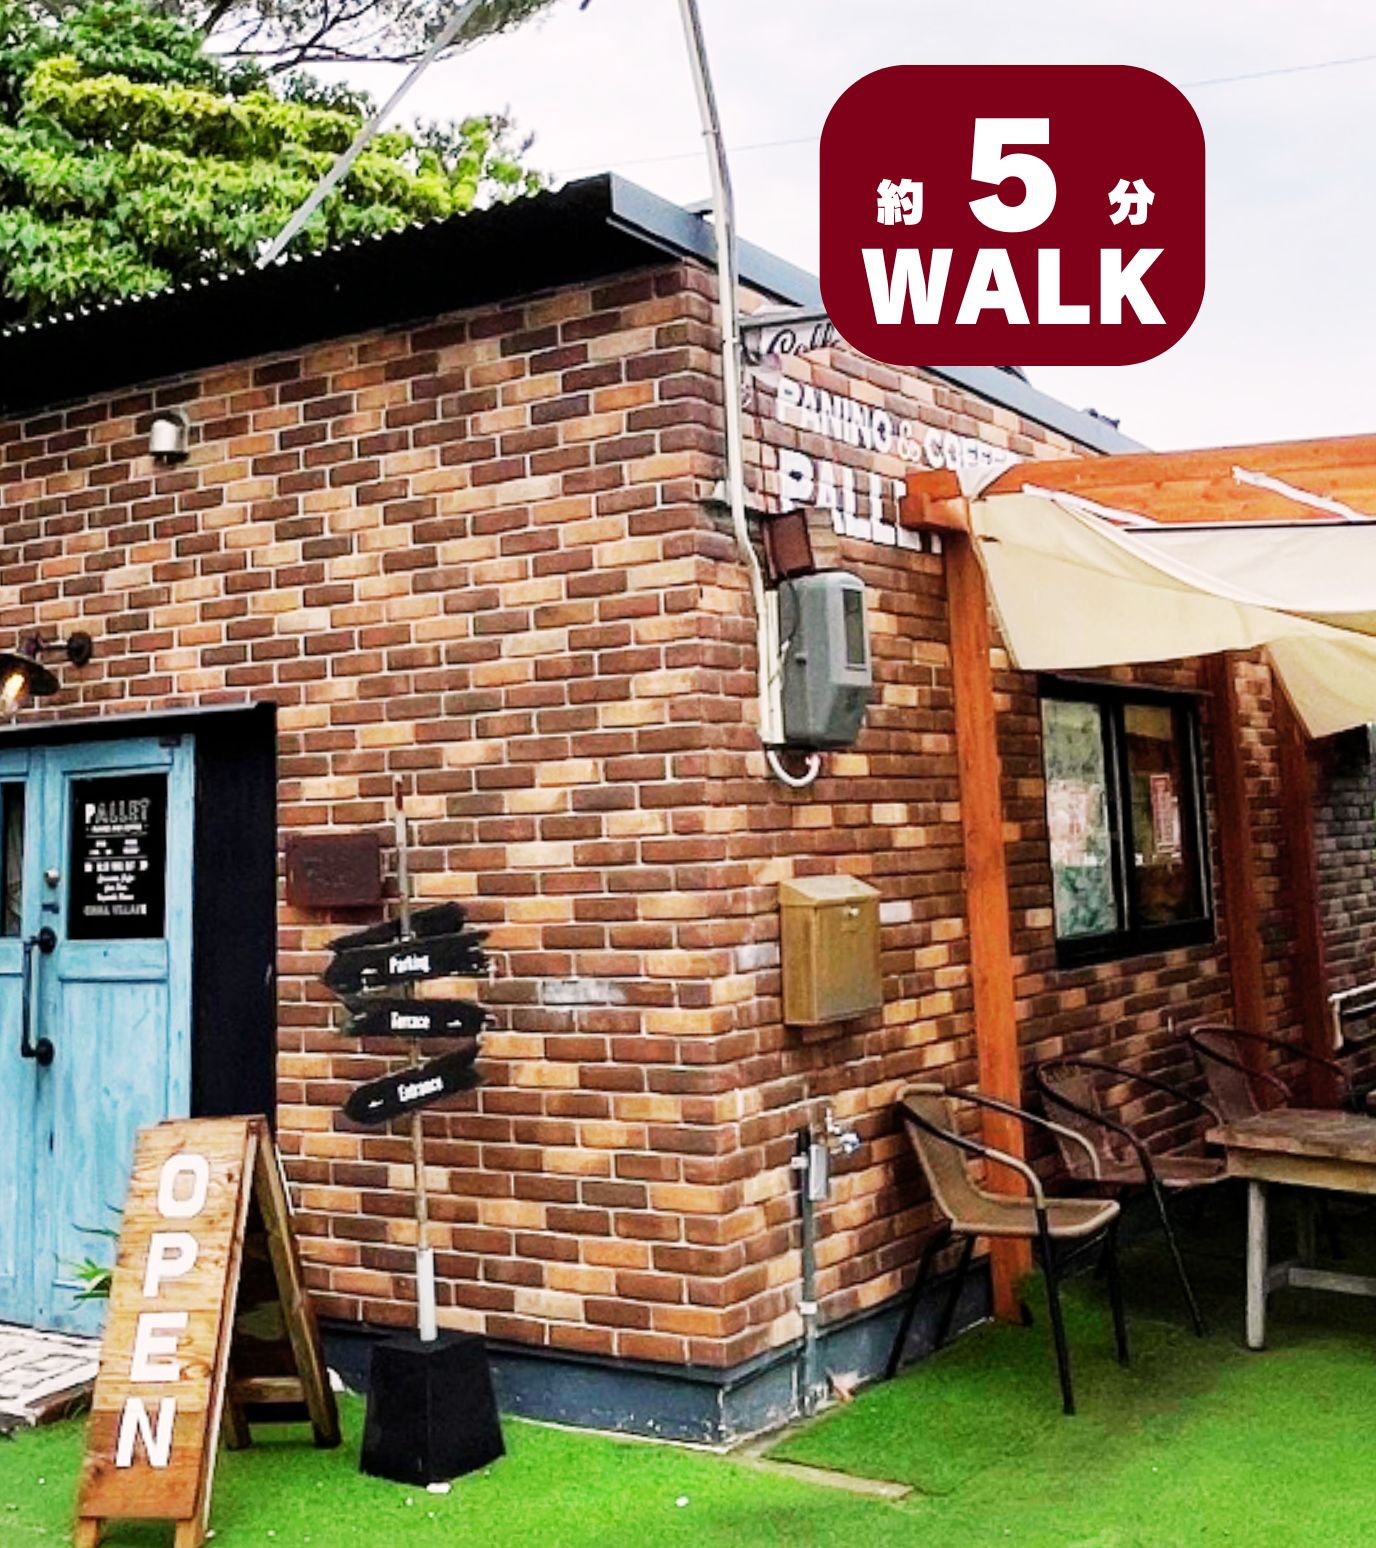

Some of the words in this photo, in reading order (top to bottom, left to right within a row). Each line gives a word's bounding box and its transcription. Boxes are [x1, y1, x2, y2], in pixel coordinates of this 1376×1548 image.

[777, 376, 892, 453] PANINO
[898, 420, 922, 462] &
[114, 1153, 209, 1468] OPEN
